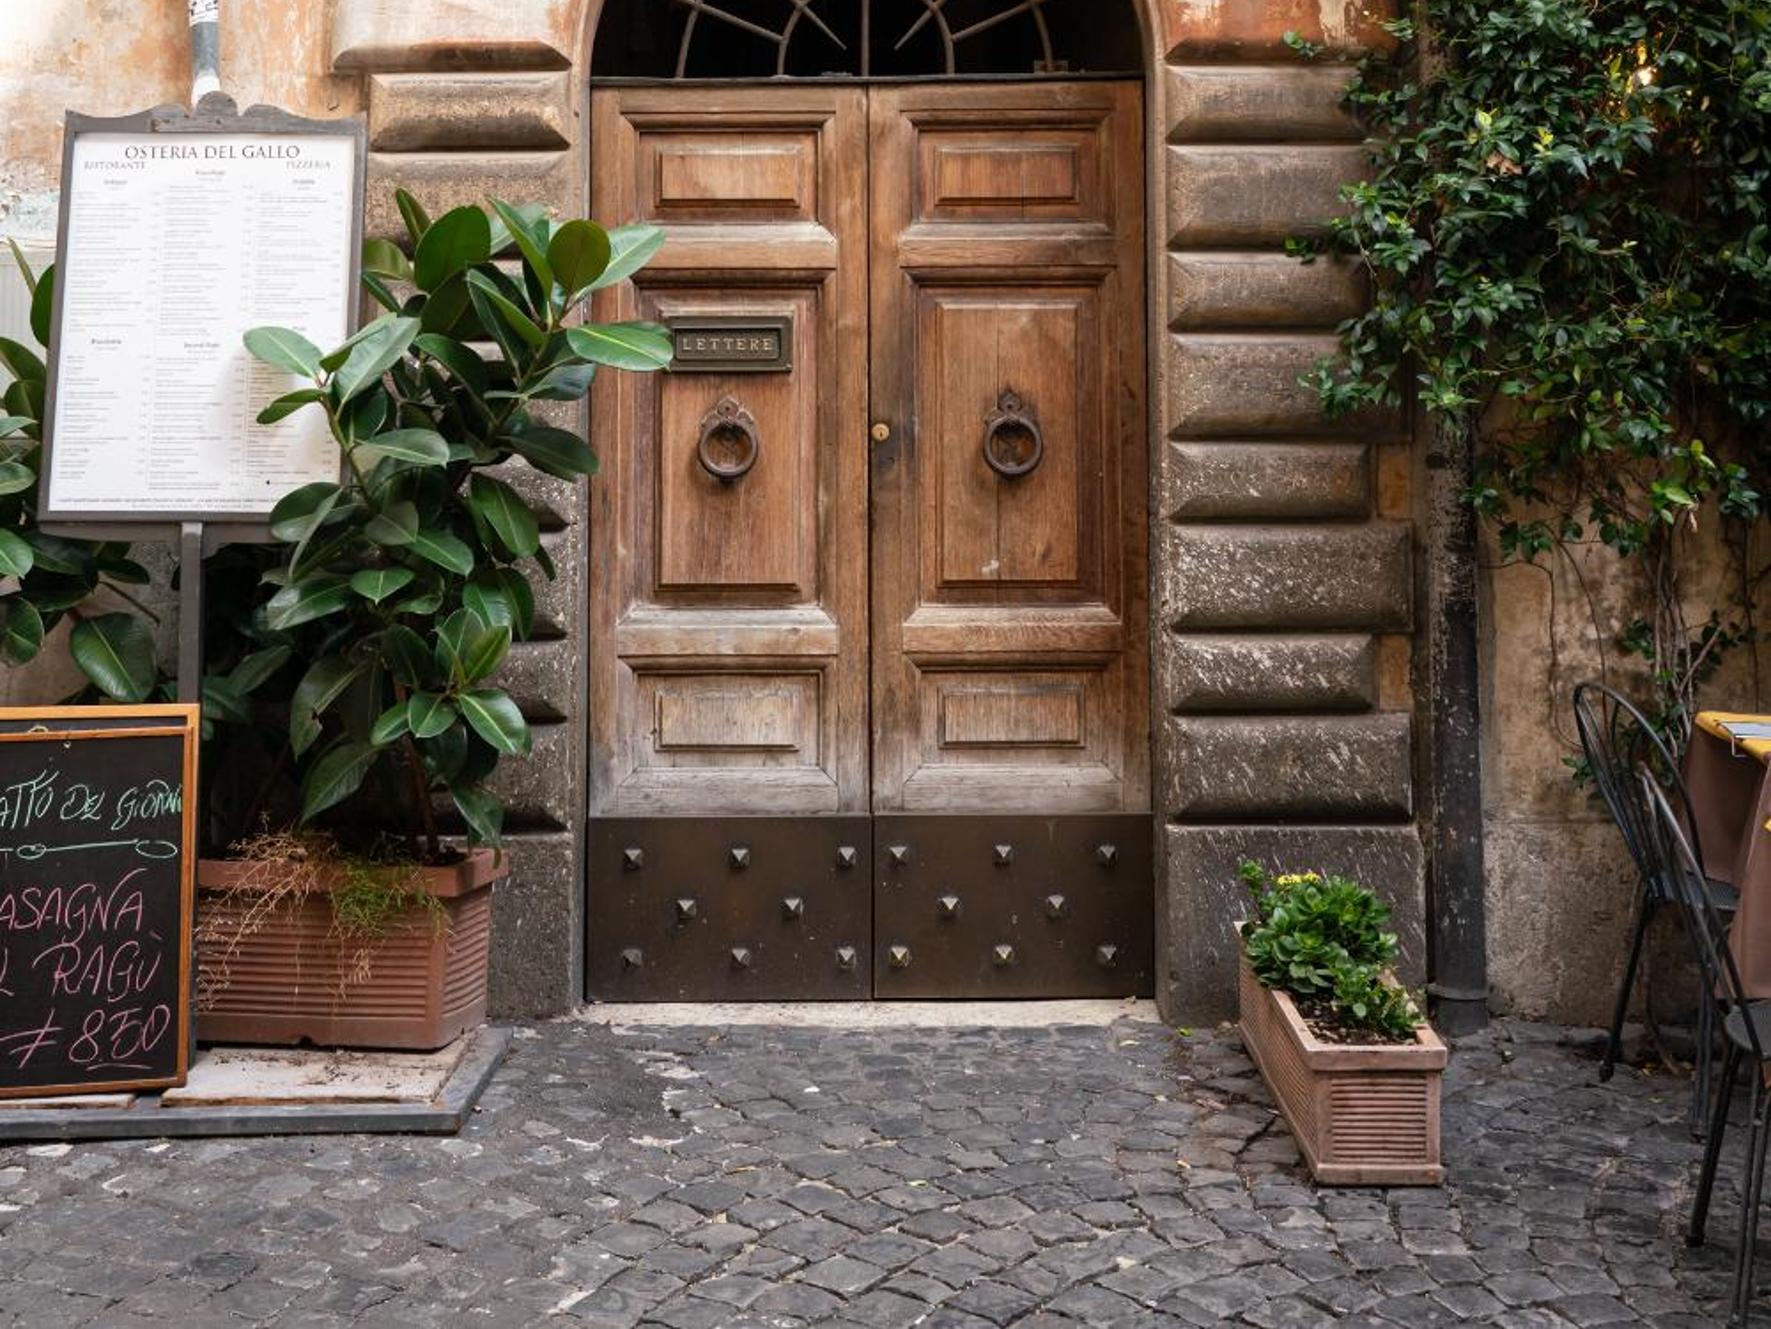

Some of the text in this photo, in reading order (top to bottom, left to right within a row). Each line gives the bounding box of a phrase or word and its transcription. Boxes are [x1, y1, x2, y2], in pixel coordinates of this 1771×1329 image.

[124, 145, 301, 160] OSTERIA DEL GALLO
[682, 337, 774, 352] LETTERE
